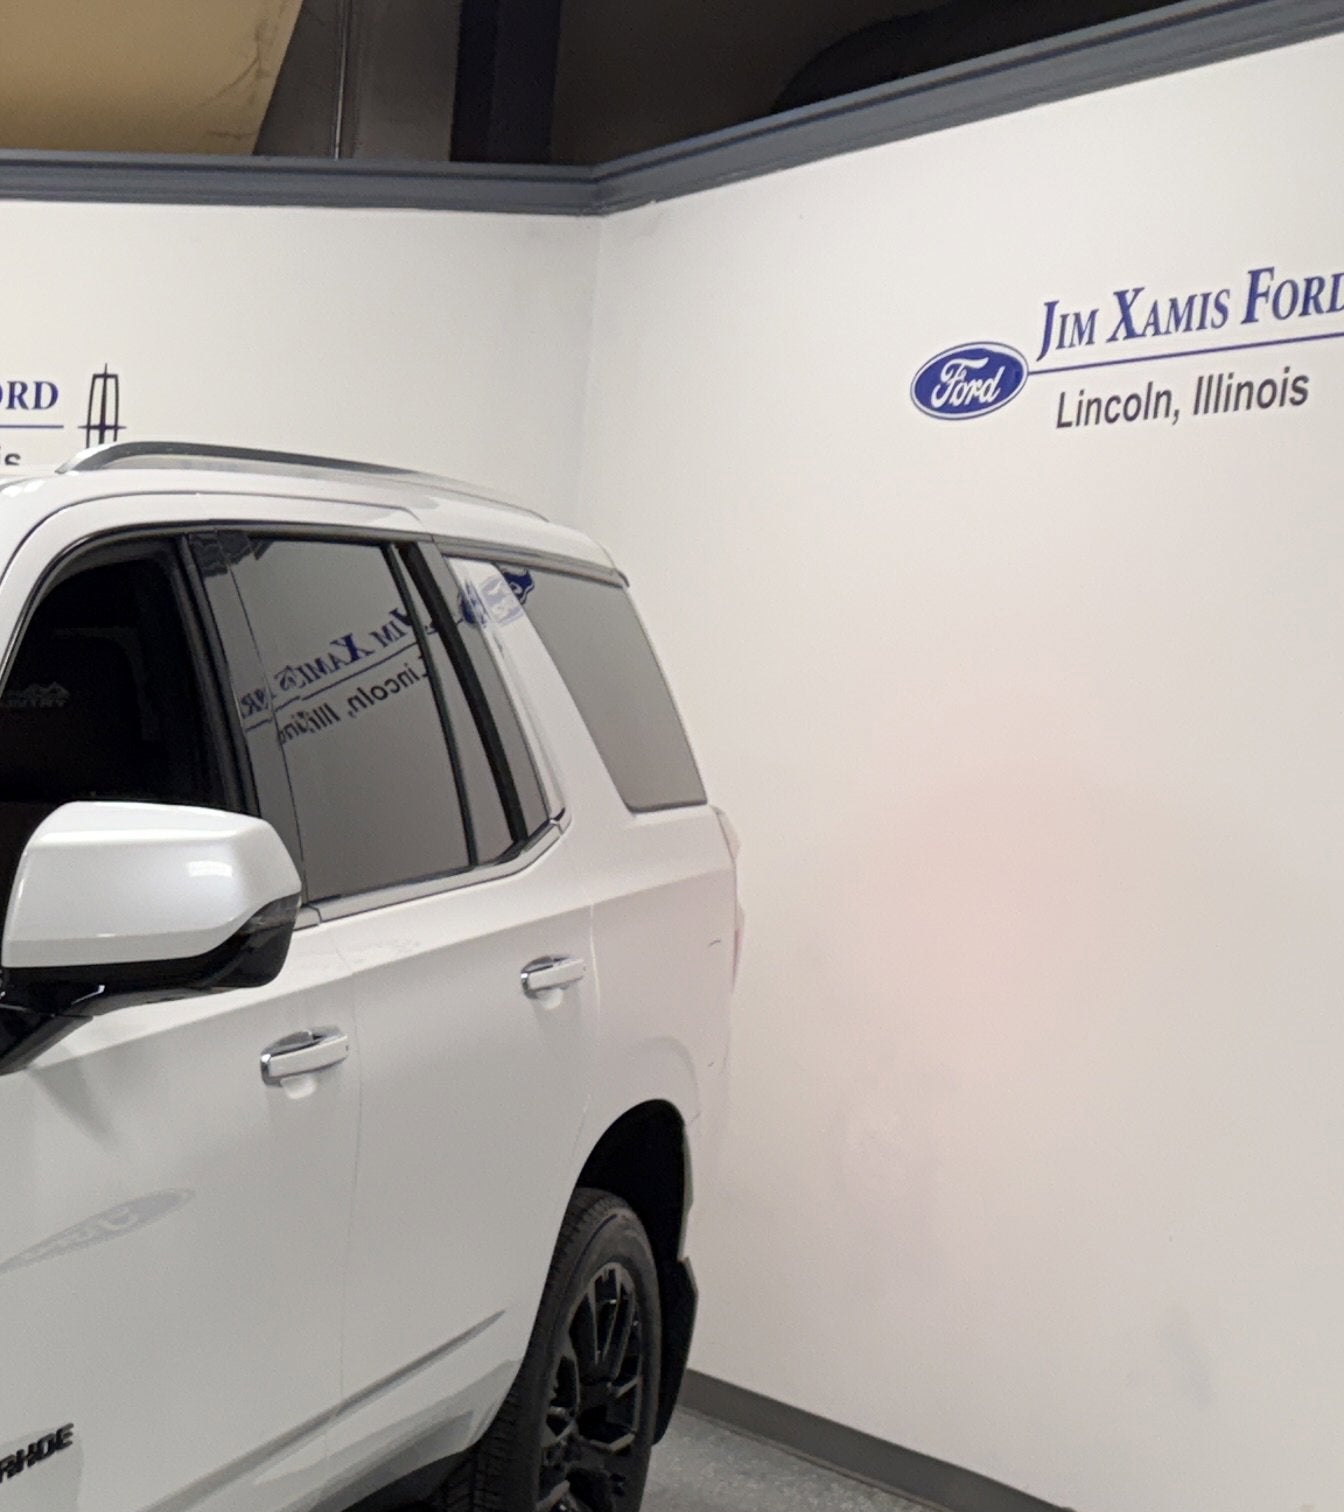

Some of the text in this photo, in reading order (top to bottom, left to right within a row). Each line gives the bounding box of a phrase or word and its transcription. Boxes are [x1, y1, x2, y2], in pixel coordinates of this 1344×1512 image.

[1036, 300, 1099, 361] JIM
[1107, 287, 1231, 343] XAMIS
[930, 356, 1006, 409] Ford
[1056, 366, 1310, 429] Lincoln, Illinois
